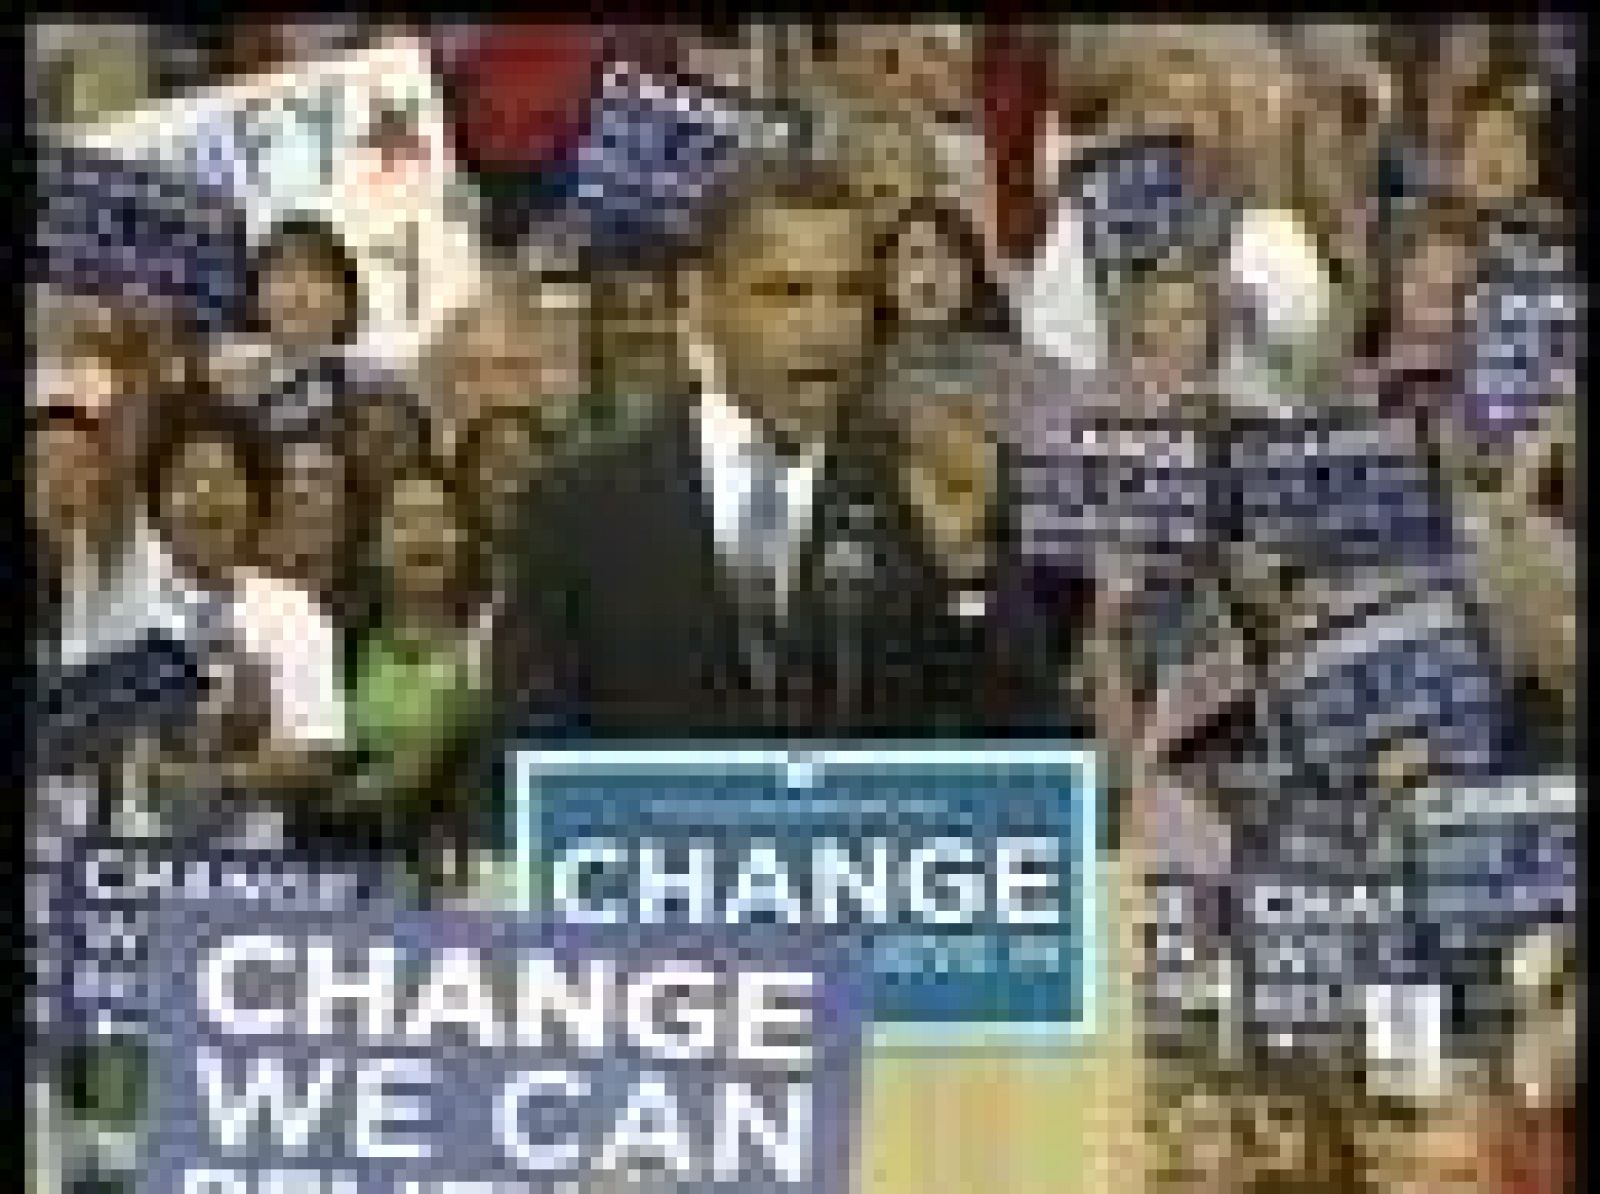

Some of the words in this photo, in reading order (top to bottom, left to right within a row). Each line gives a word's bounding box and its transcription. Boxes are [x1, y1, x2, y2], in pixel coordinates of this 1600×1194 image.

[553, 837, 1060, 924] CHANGE
[200, 936, 813, 1059] CHANGE
[198, 1046, 432, 1158] WE
[493, 1070, 812, 1182] CAN
